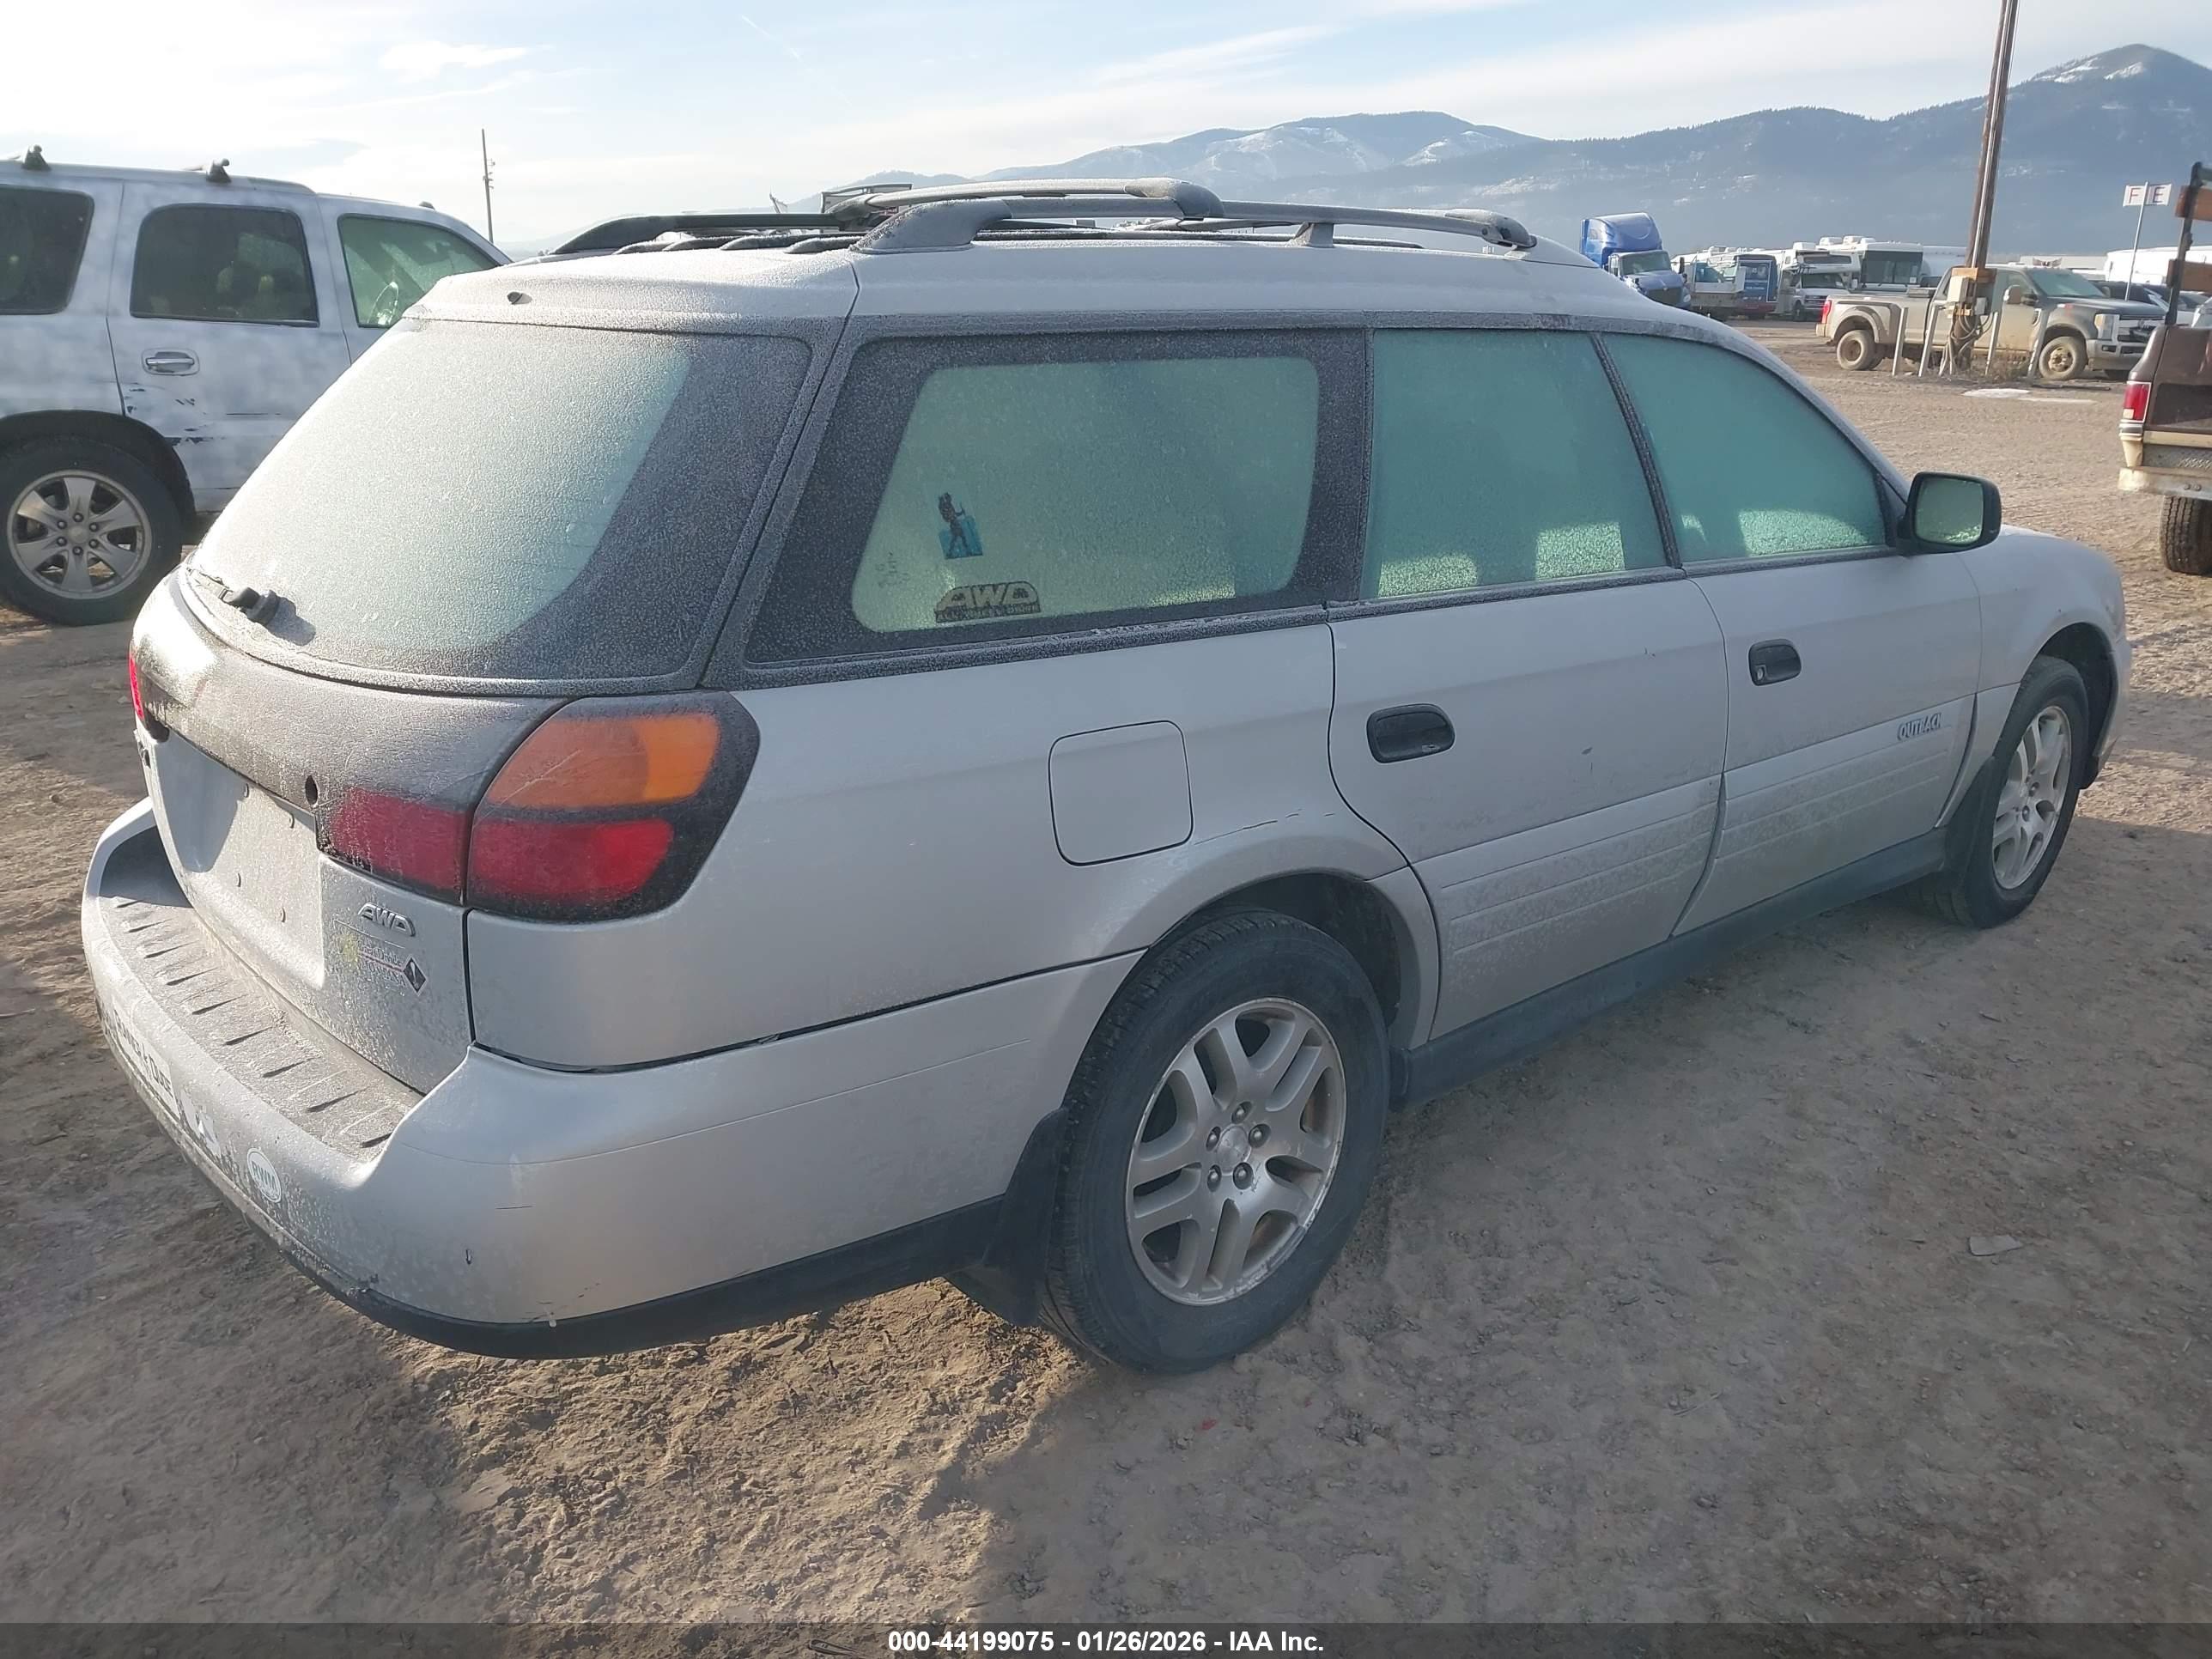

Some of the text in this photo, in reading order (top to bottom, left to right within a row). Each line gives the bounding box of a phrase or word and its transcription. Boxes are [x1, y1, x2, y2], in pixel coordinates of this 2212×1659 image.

[2130, 187, 2141, 204] F
[2153, 186, 2166, 203] E
[936, 581, 1039, 611] AWD
[357, 902, 416, 938] AWD
